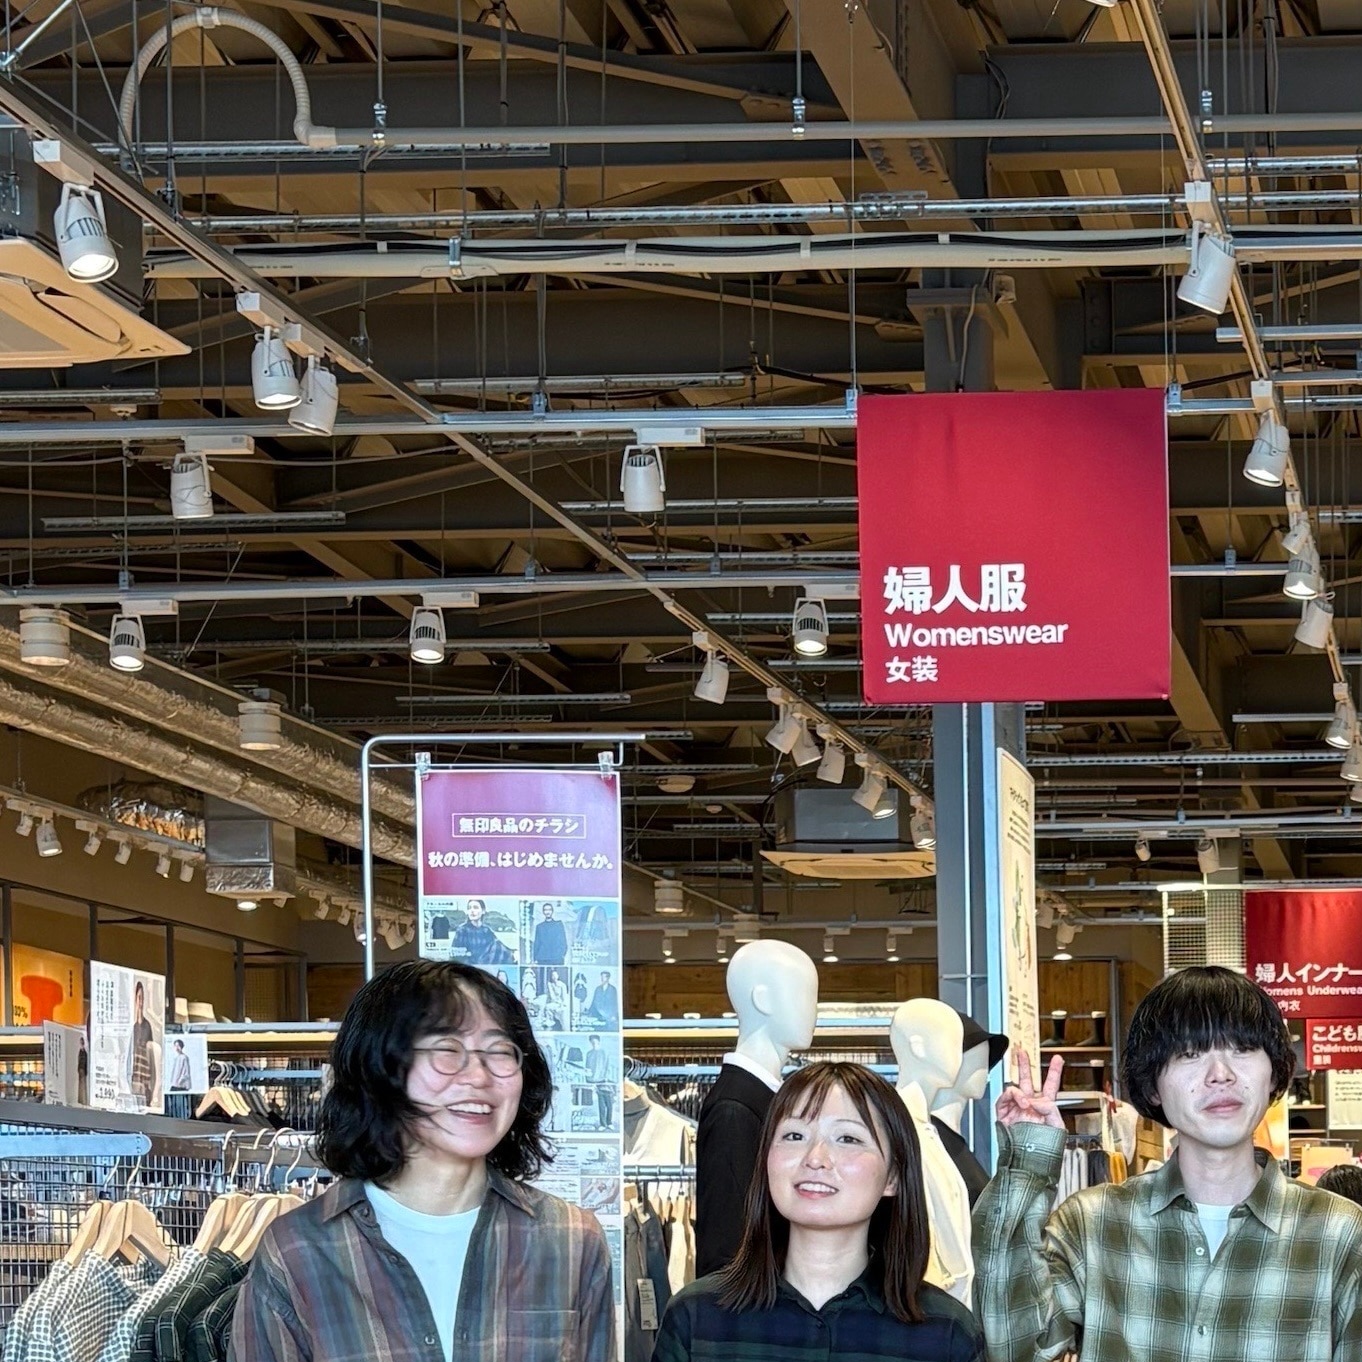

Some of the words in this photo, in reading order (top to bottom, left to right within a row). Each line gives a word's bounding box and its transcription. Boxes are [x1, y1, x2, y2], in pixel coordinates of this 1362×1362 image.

[883, 563, 1028, 615] 婦人服
[884, 622, 1069, 648] Womenswear
[885, 654, 939, 683] 女装
[459, 816, 579, 834] 無印良品のチラシ
